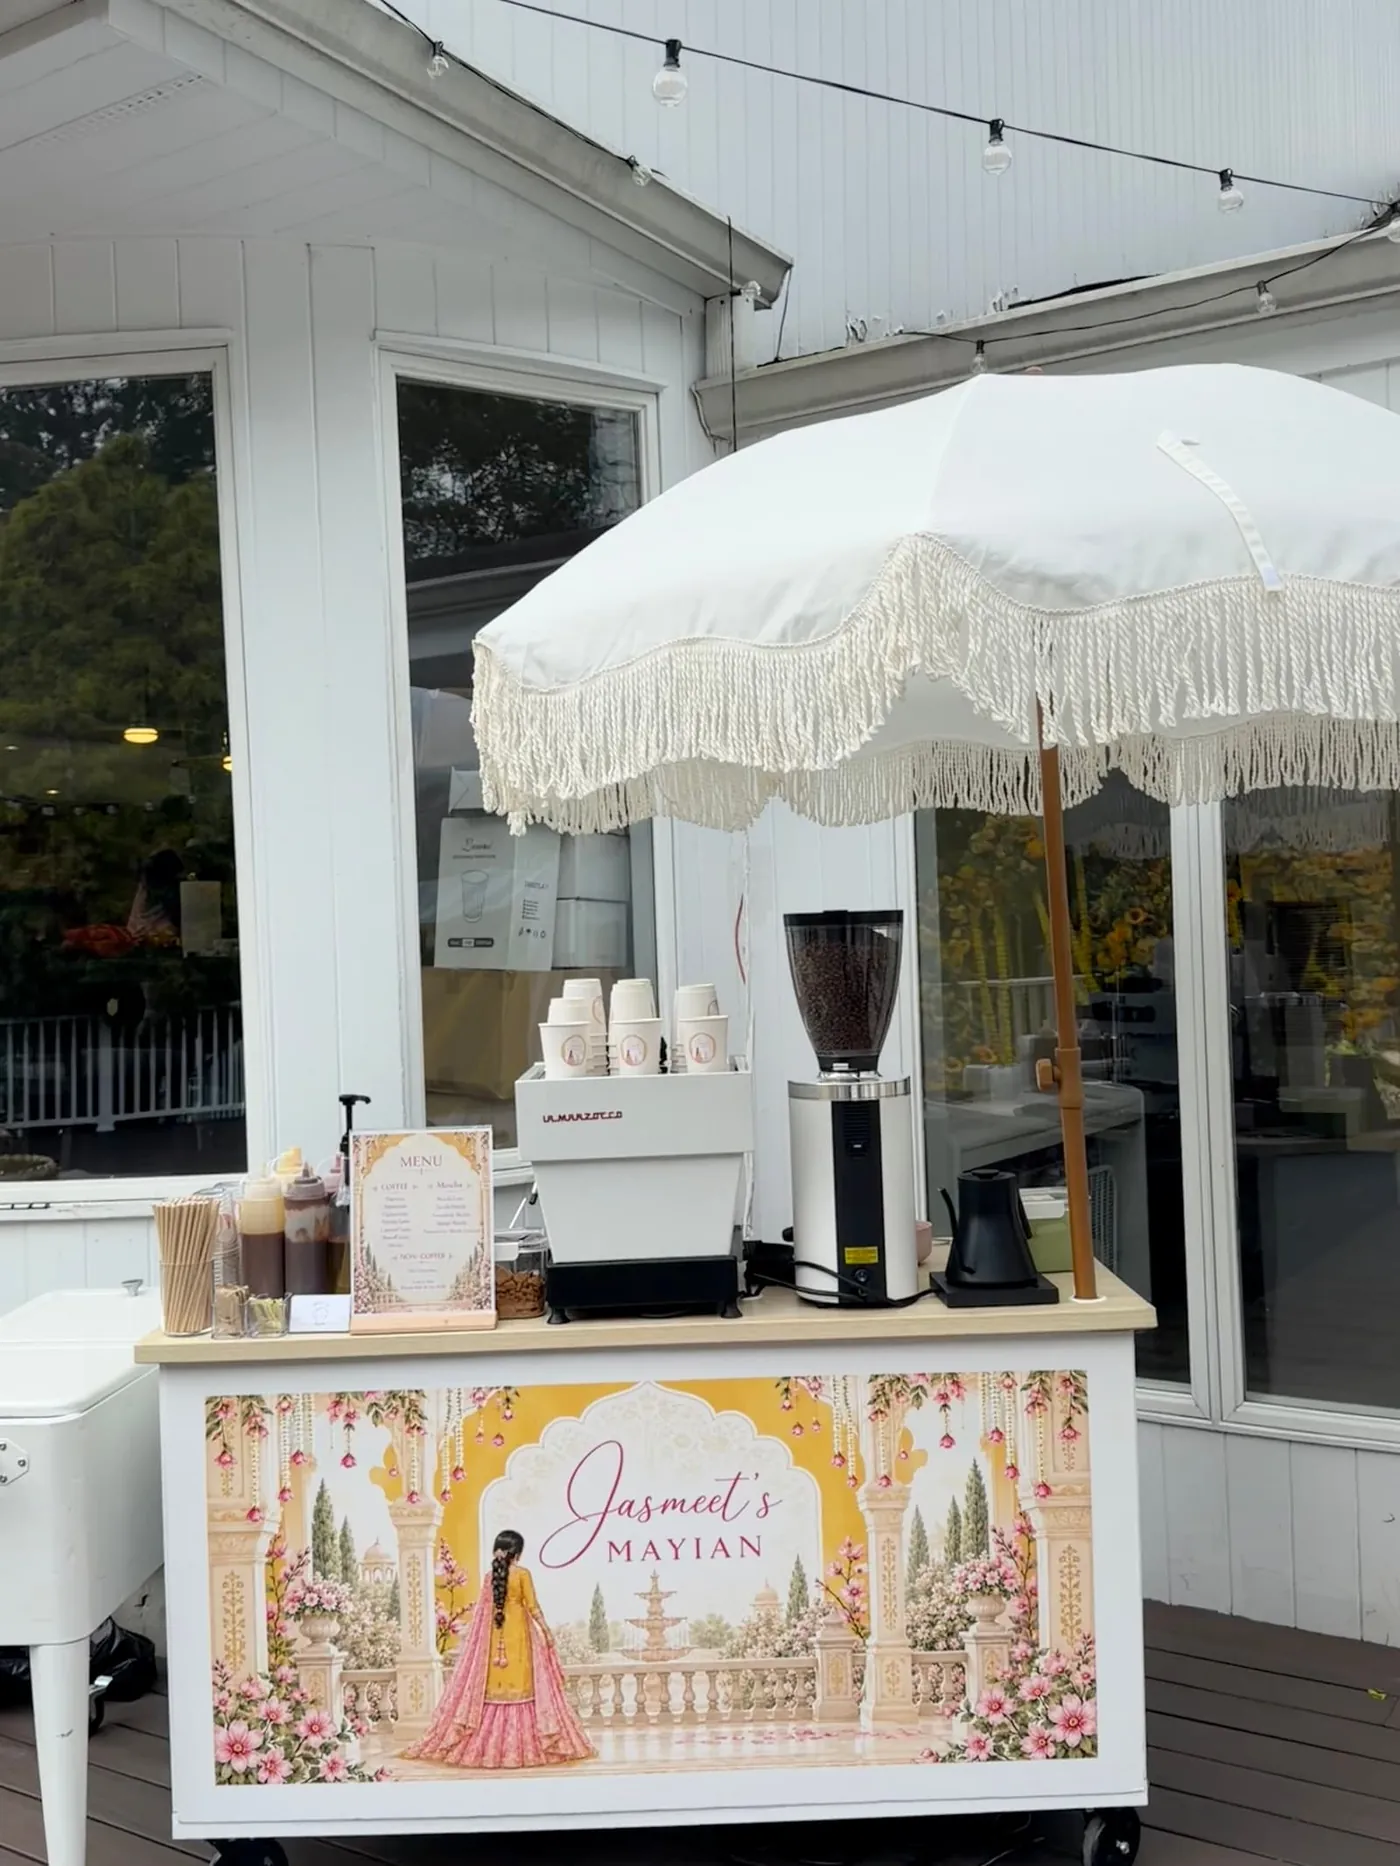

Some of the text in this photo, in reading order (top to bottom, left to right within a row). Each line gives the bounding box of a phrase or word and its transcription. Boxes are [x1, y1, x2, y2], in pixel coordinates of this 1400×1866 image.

[400, 1155, 443, 1168] MENU
[540, 1440, 783, 1569] Jasmeet's
[607, 1535, 762, 1563] MAYIAN
